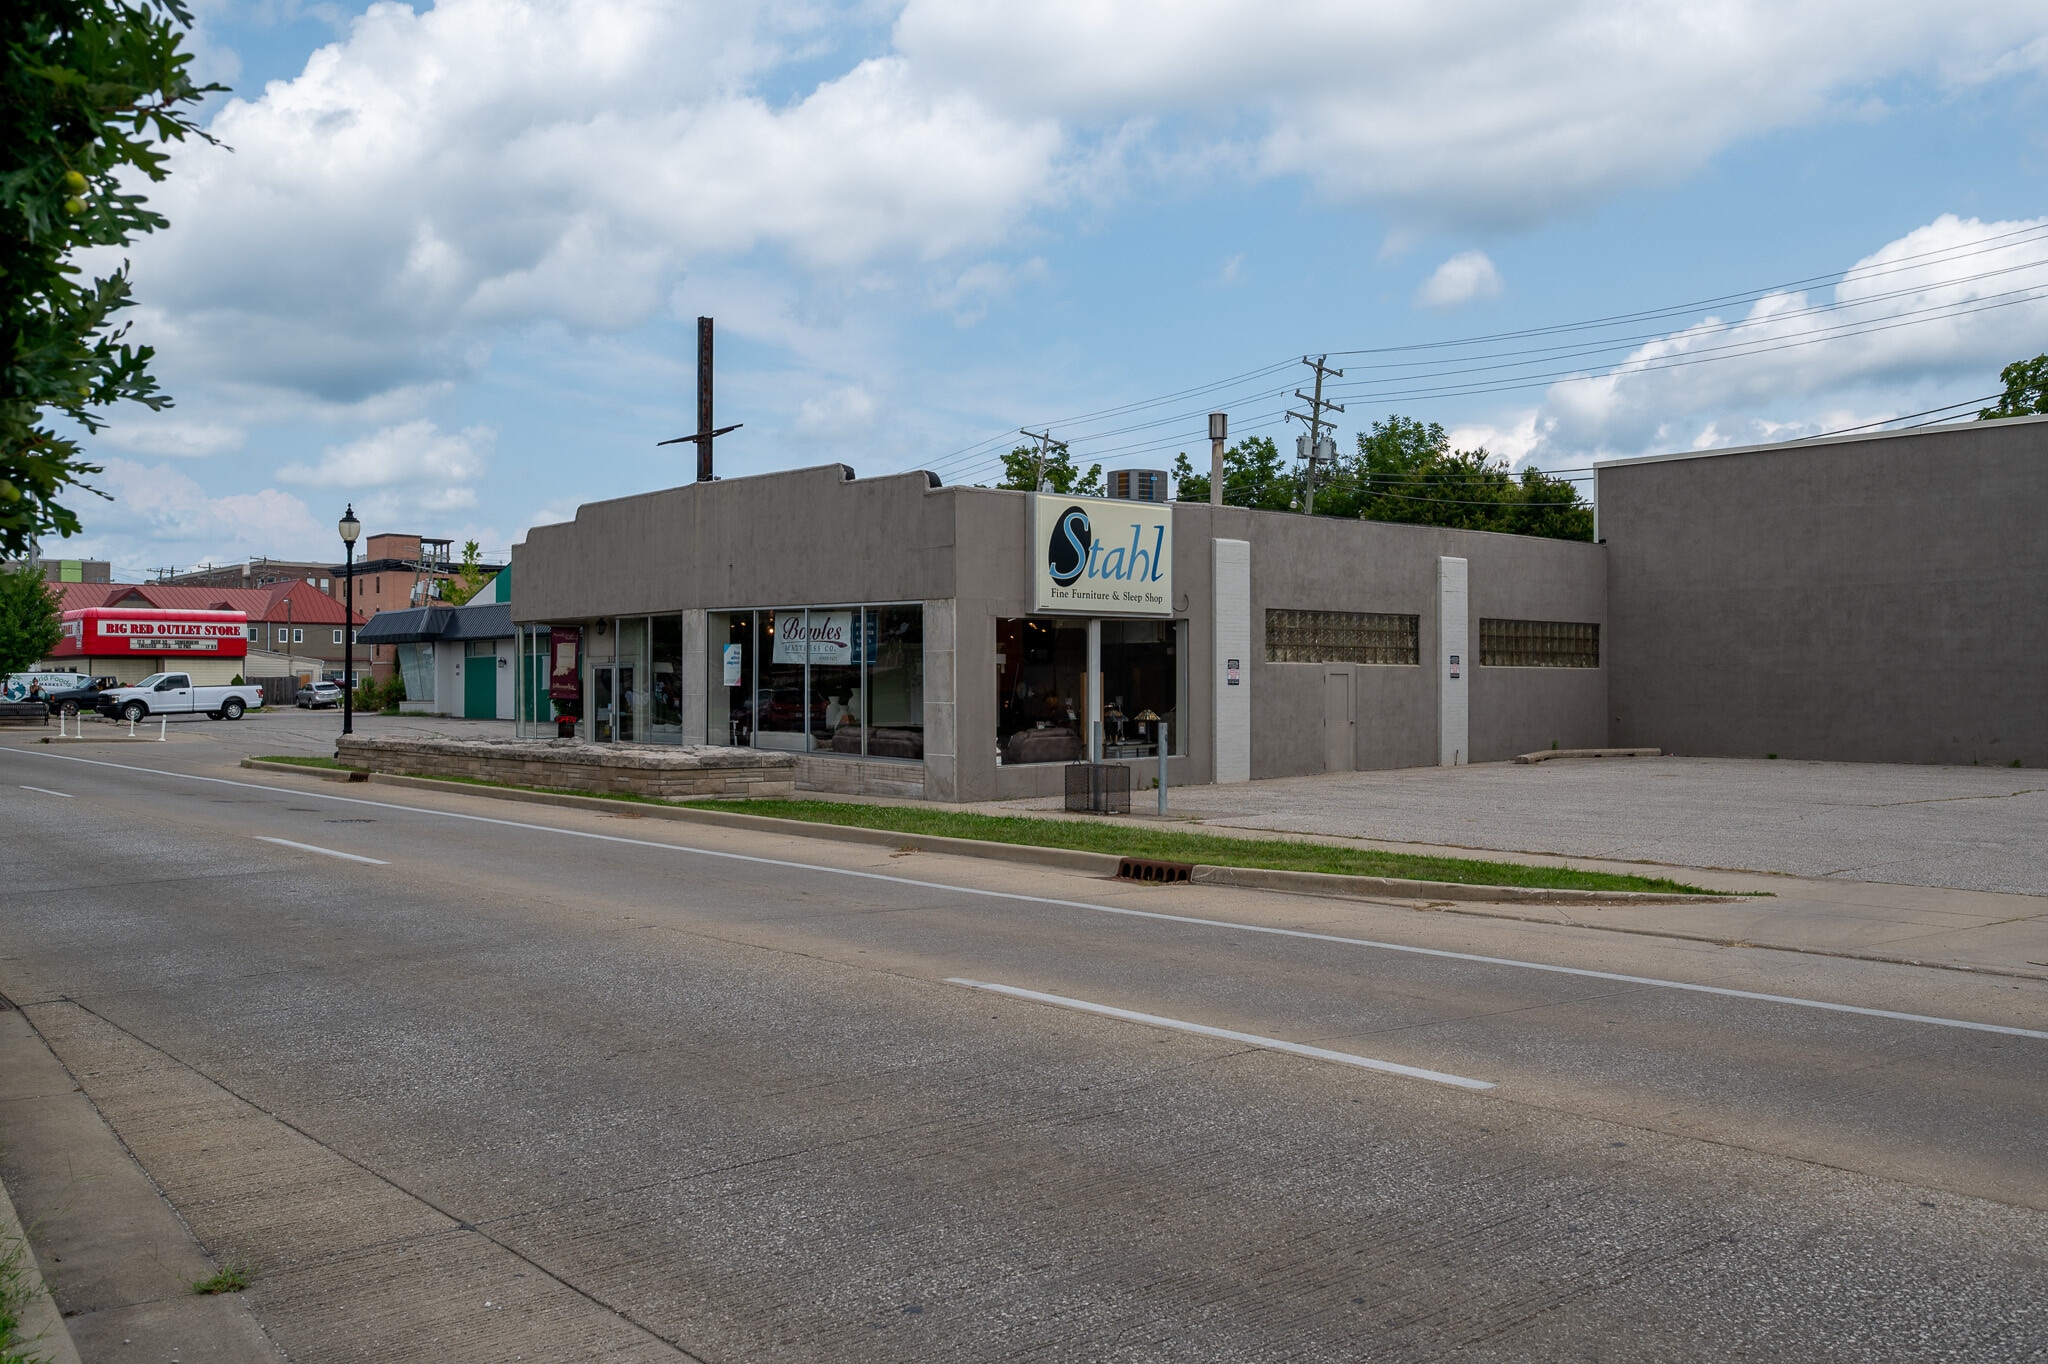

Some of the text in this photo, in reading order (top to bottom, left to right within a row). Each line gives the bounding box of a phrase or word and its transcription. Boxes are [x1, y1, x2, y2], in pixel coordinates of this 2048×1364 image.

[1049, 511, 1165, 583] Stahl
[1051, 588, 1163, 604] Fine Furniture & Sleep Shop
[106, 623, 241, 636] BIG RED OUTLET STORE
[782, 616, 842, 640] Bowles
[50, 675, 72, 687] Foods
[555, 715, 577, 724] OPEN
